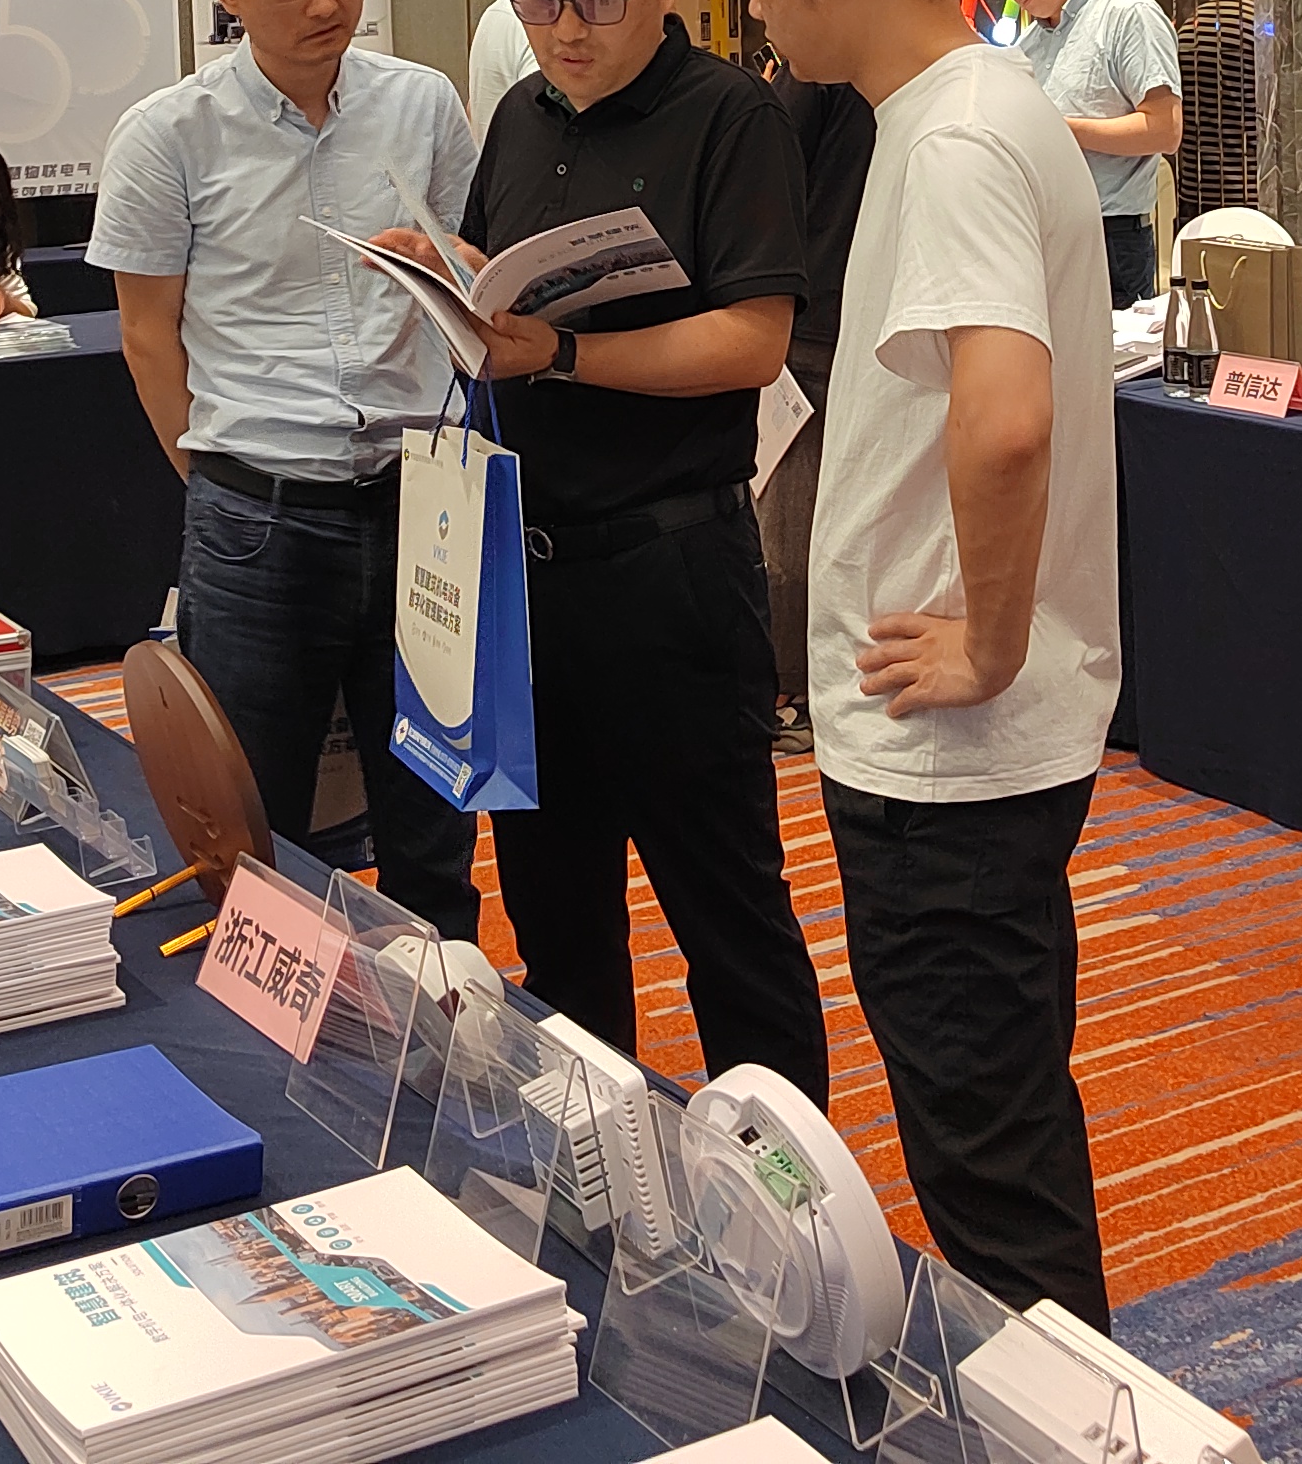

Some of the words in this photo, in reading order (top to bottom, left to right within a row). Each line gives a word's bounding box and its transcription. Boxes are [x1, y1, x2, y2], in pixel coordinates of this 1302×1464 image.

[1224, 370, 1283, 402] 普信达
[214, 906, 326, 1024] 浙江威奇
[53, 1268, 122, 1327] 智慧建筑
[334, 1279, 370, 1303] SMART
[90, 1381, 122, 1404] VKIE
